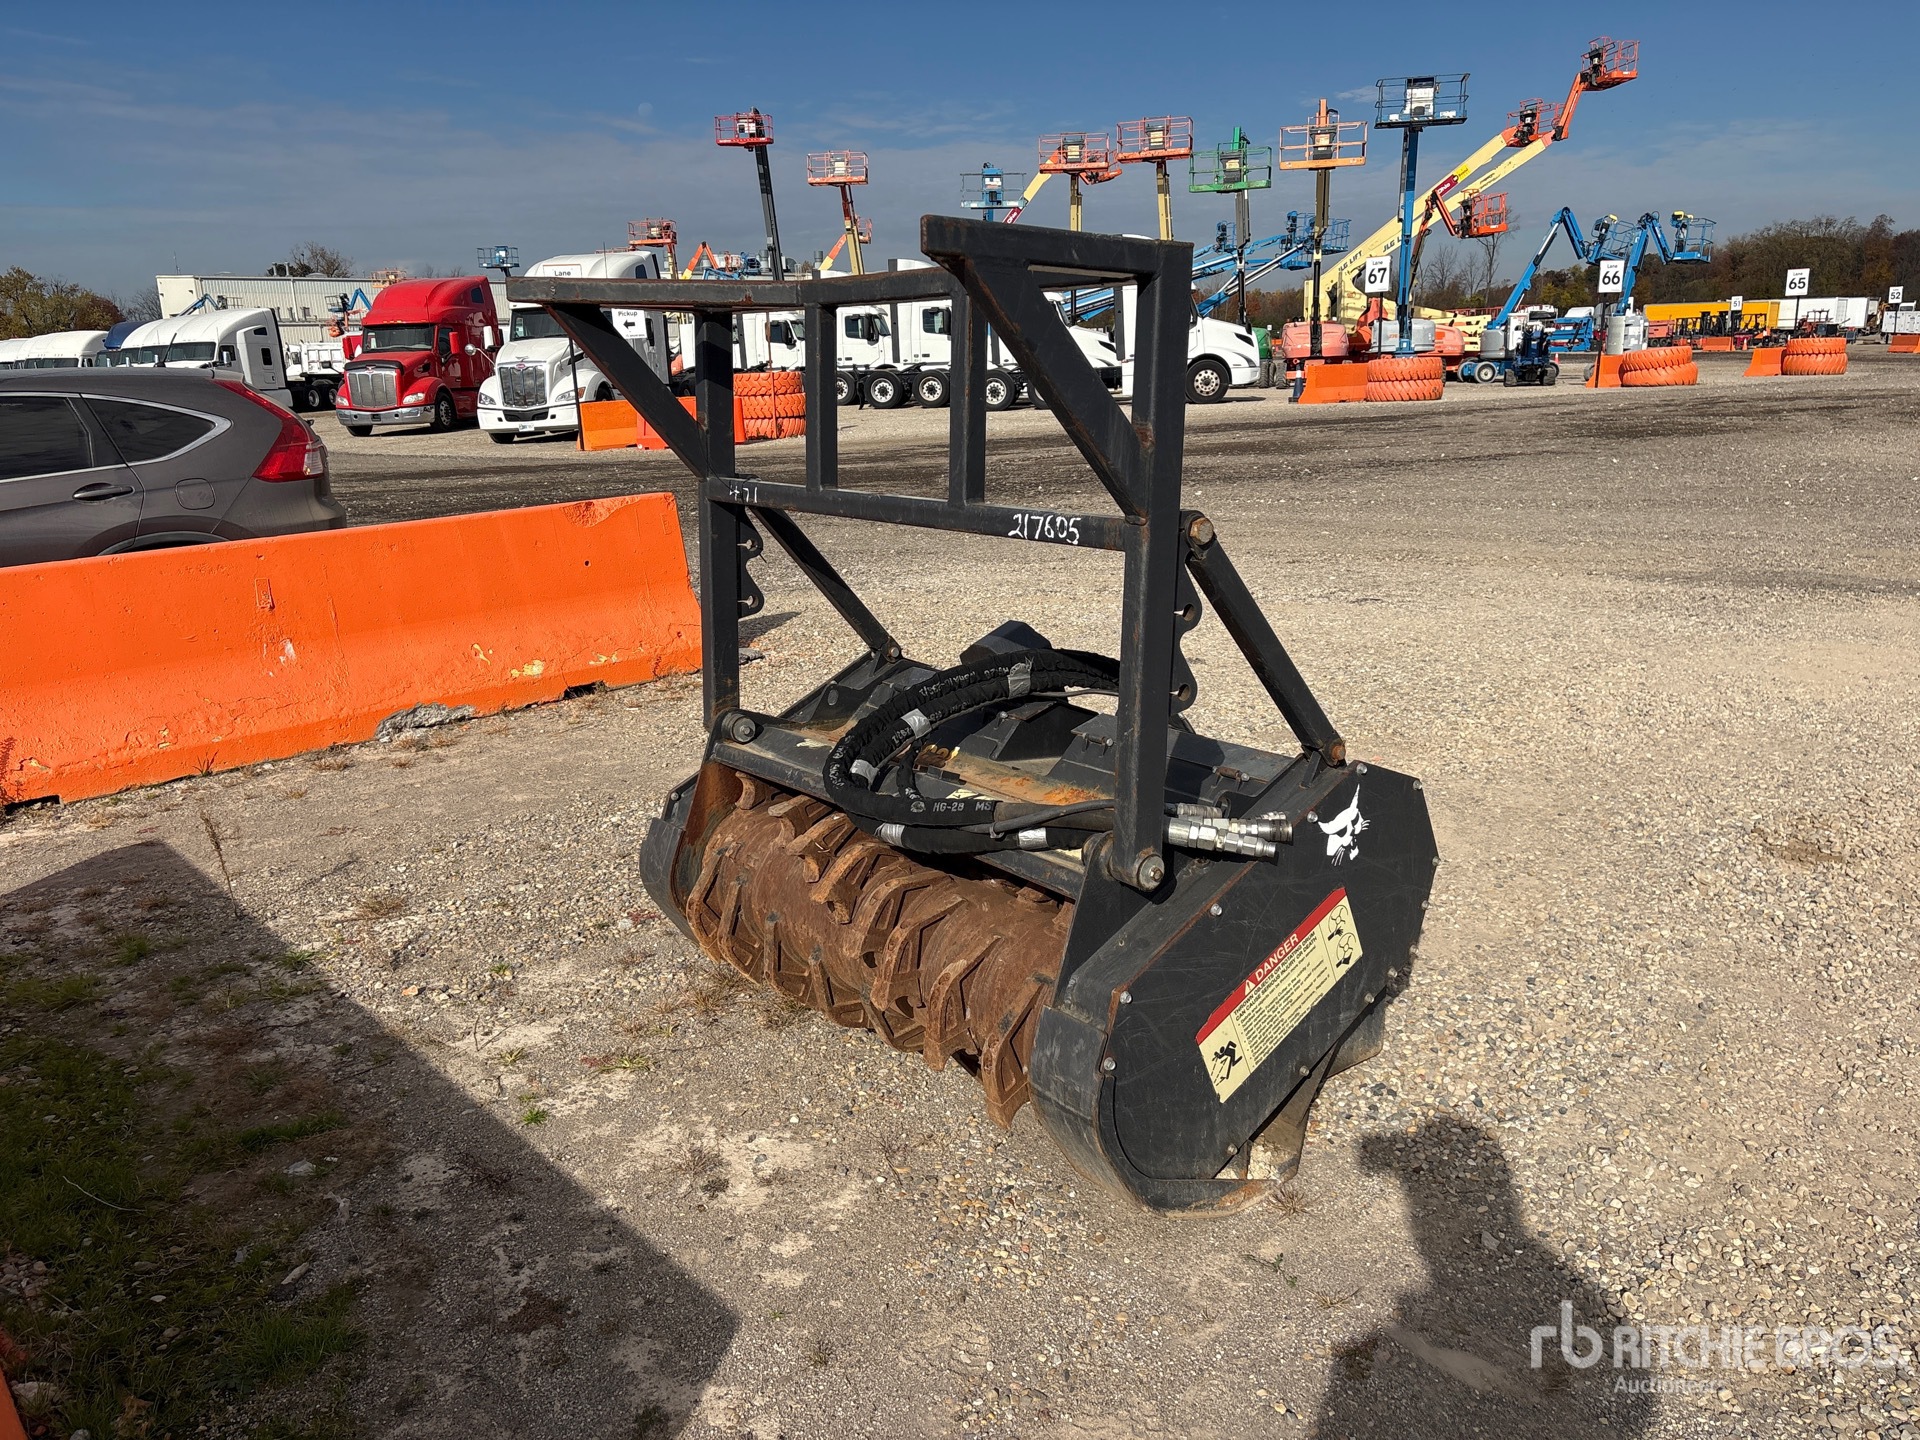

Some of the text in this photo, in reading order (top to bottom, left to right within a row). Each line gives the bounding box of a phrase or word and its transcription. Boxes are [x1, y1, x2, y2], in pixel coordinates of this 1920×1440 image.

[1382, 240, 1396, 253] JLG
[1349, 250, 1363, 264] LIFT
[1367, 267, 1387, 284] 67
[1602, 270, 1621, 285] 66
[1788, 277, 1806, 290] 65
[1890, 291, 1901, 300] 52
[617, 310, 638, 318] Pickup
[1007, 513, 1082, 545] 217605
[1255, 933, 1299, 981] DANGER
[1233, 930, 1315, 1016] THROWN OBJECTS OR ROTATING DRUM
[1235, 935, 1317, 1021] CAN CAUSE SERIOUS INJURY OR DEATH
